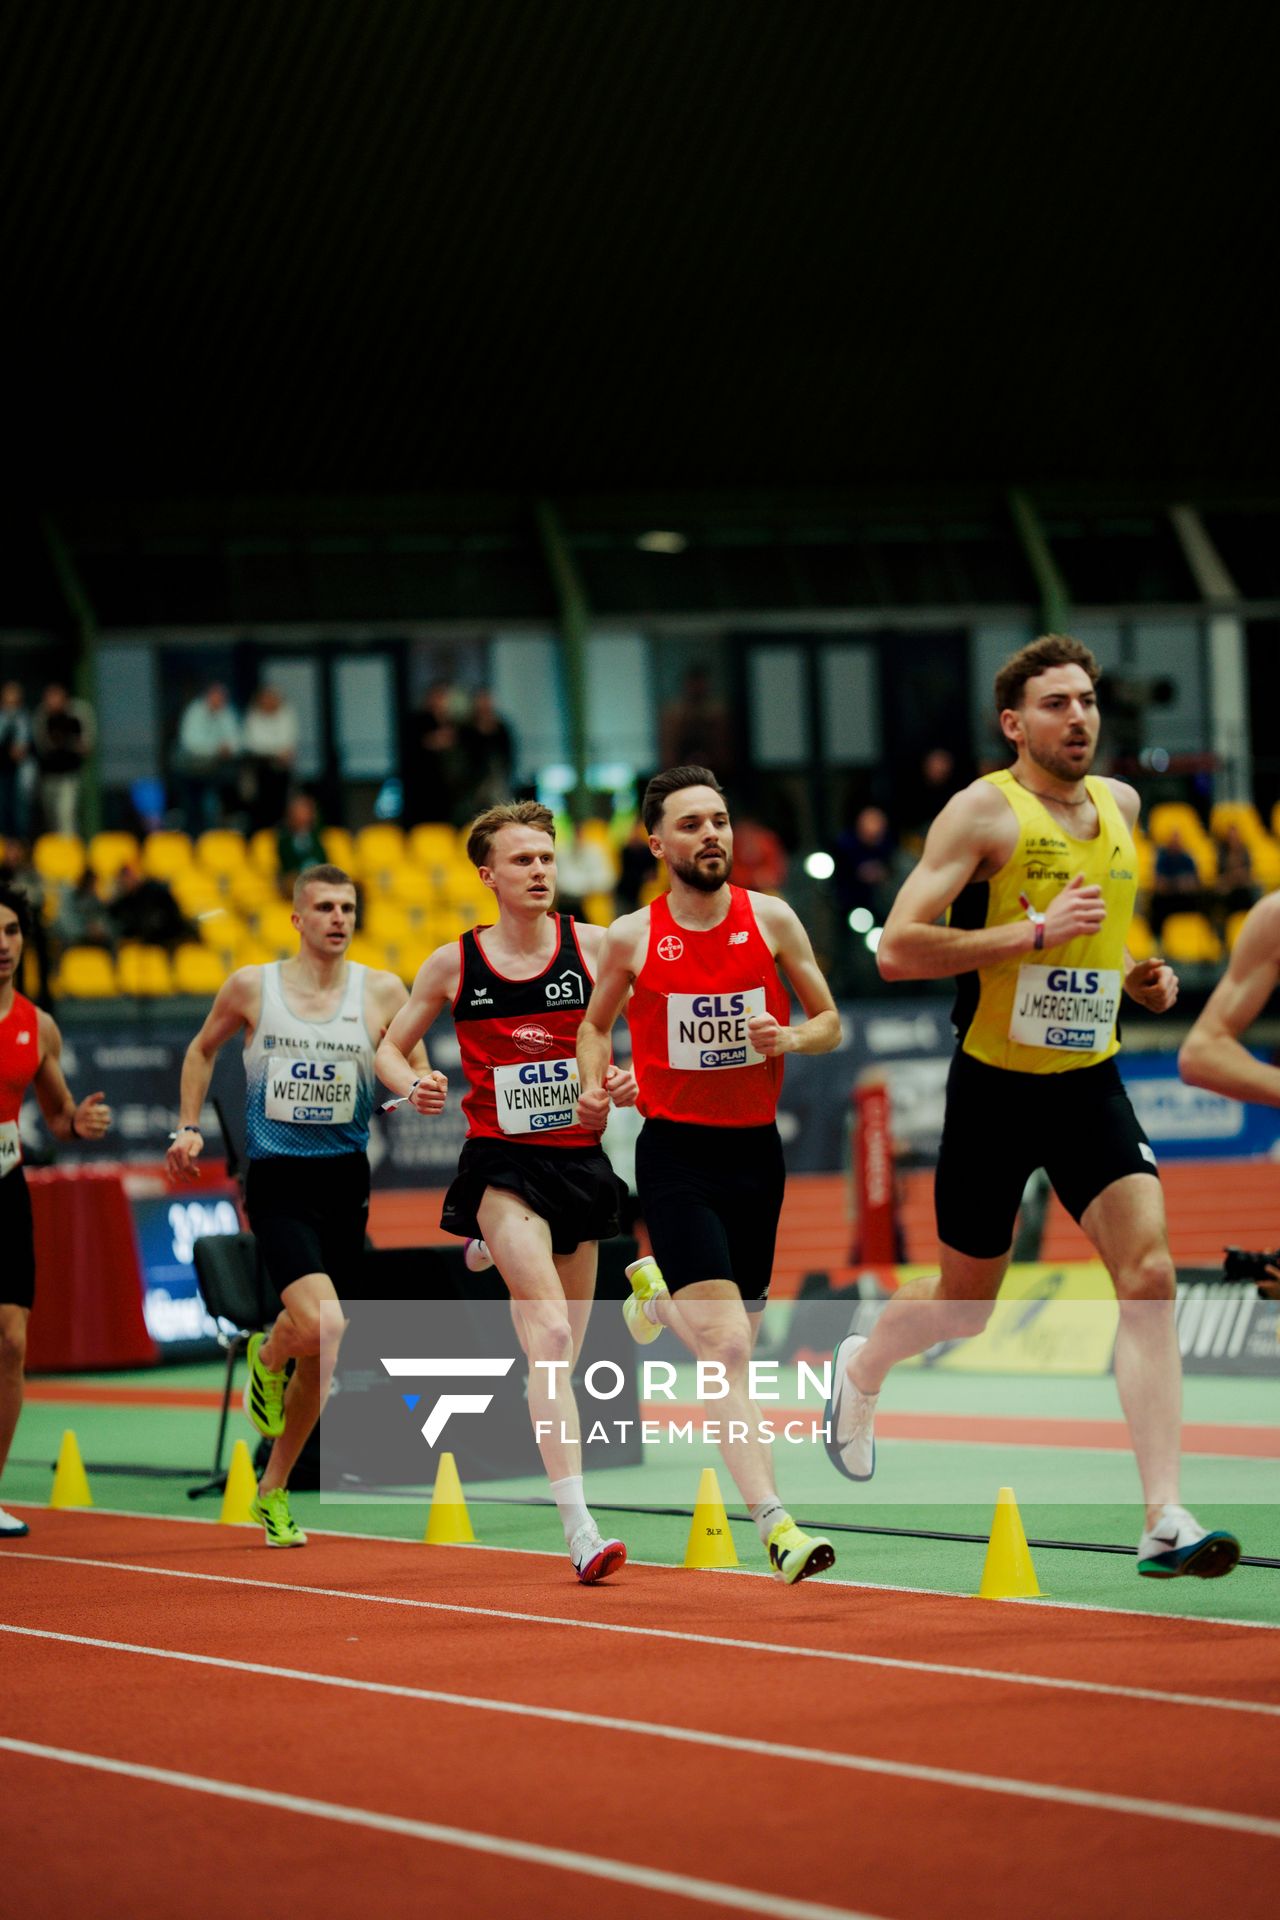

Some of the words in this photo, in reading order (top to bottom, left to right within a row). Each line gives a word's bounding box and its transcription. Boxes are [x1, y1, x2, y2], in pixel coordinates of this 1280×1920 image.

[545, 982, 573, 1000] OS
[470, 997, 494, 1006] erima
[679, 1016, 756, 1044] NORE
[278, 1037, 309, 1049] TELIS
[316, 1041, 361, 1054] FINANZ
[720, 1049, 745, 1060] PLAN
[273, 1080, 351, 1102] WEIZINGER
[504, 1082, 583, 1110] VENNEMAN
[548, 1112, 571, 1122] PLAN
[0, 1140, 16, 1157] HA
